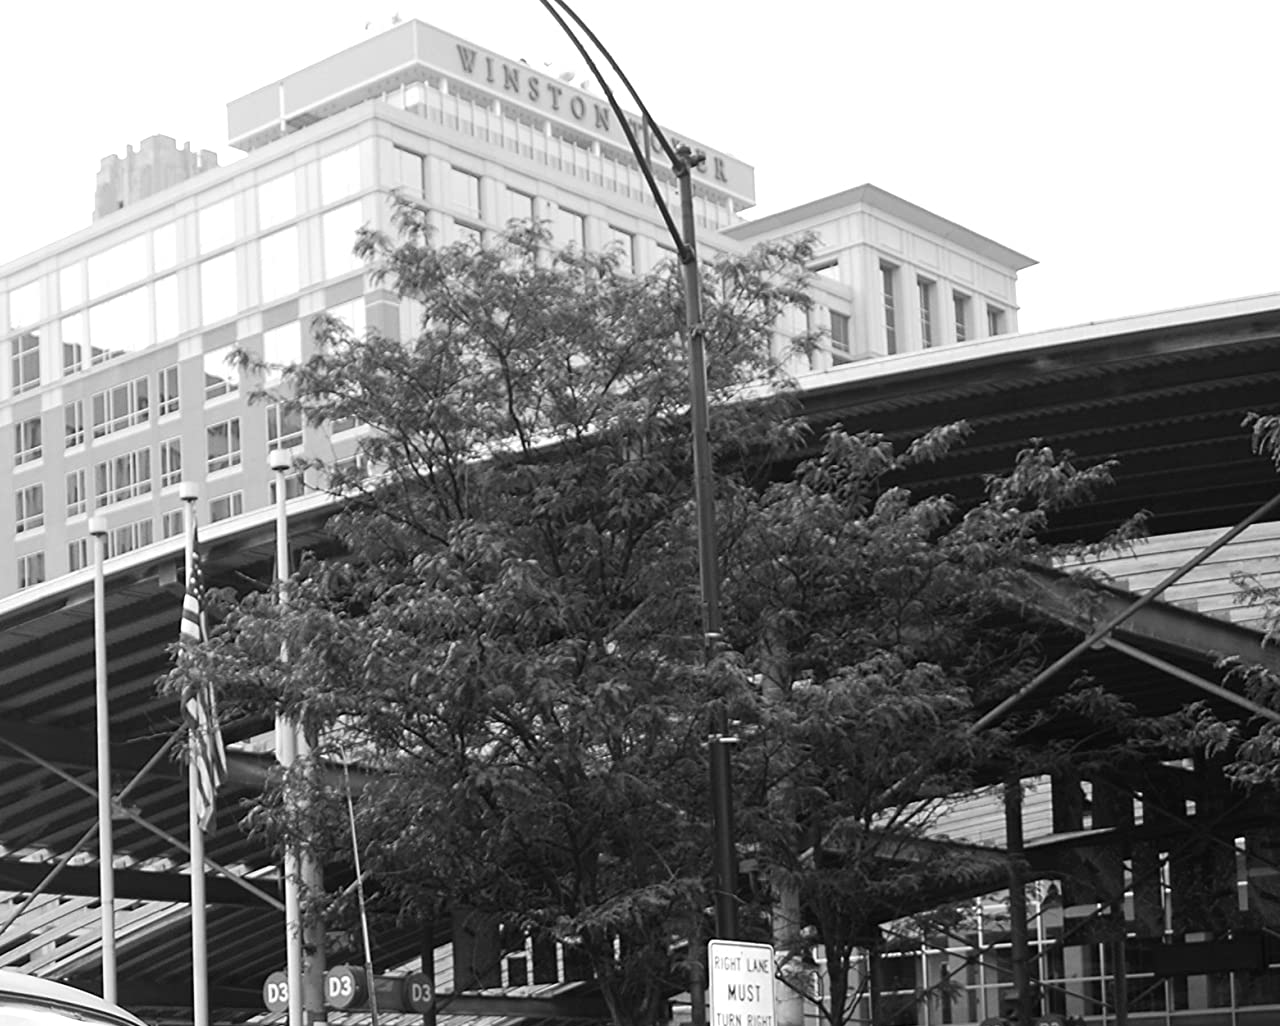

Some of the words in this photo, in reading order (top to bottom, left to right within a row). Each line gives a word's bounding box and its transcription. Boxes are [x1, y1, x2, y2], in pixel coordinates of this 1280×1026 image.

[456, 43, 613, 132] WINSTON
[714, 956, 741, 971] RIGHT
[746, 957, 770, 974] LANE
[267, 982, 289, 1003] D3
[329, 975, 353, 997] D3
[412, 983, 432, 1002] D3
[727, 983, 761, 1003] MUST
